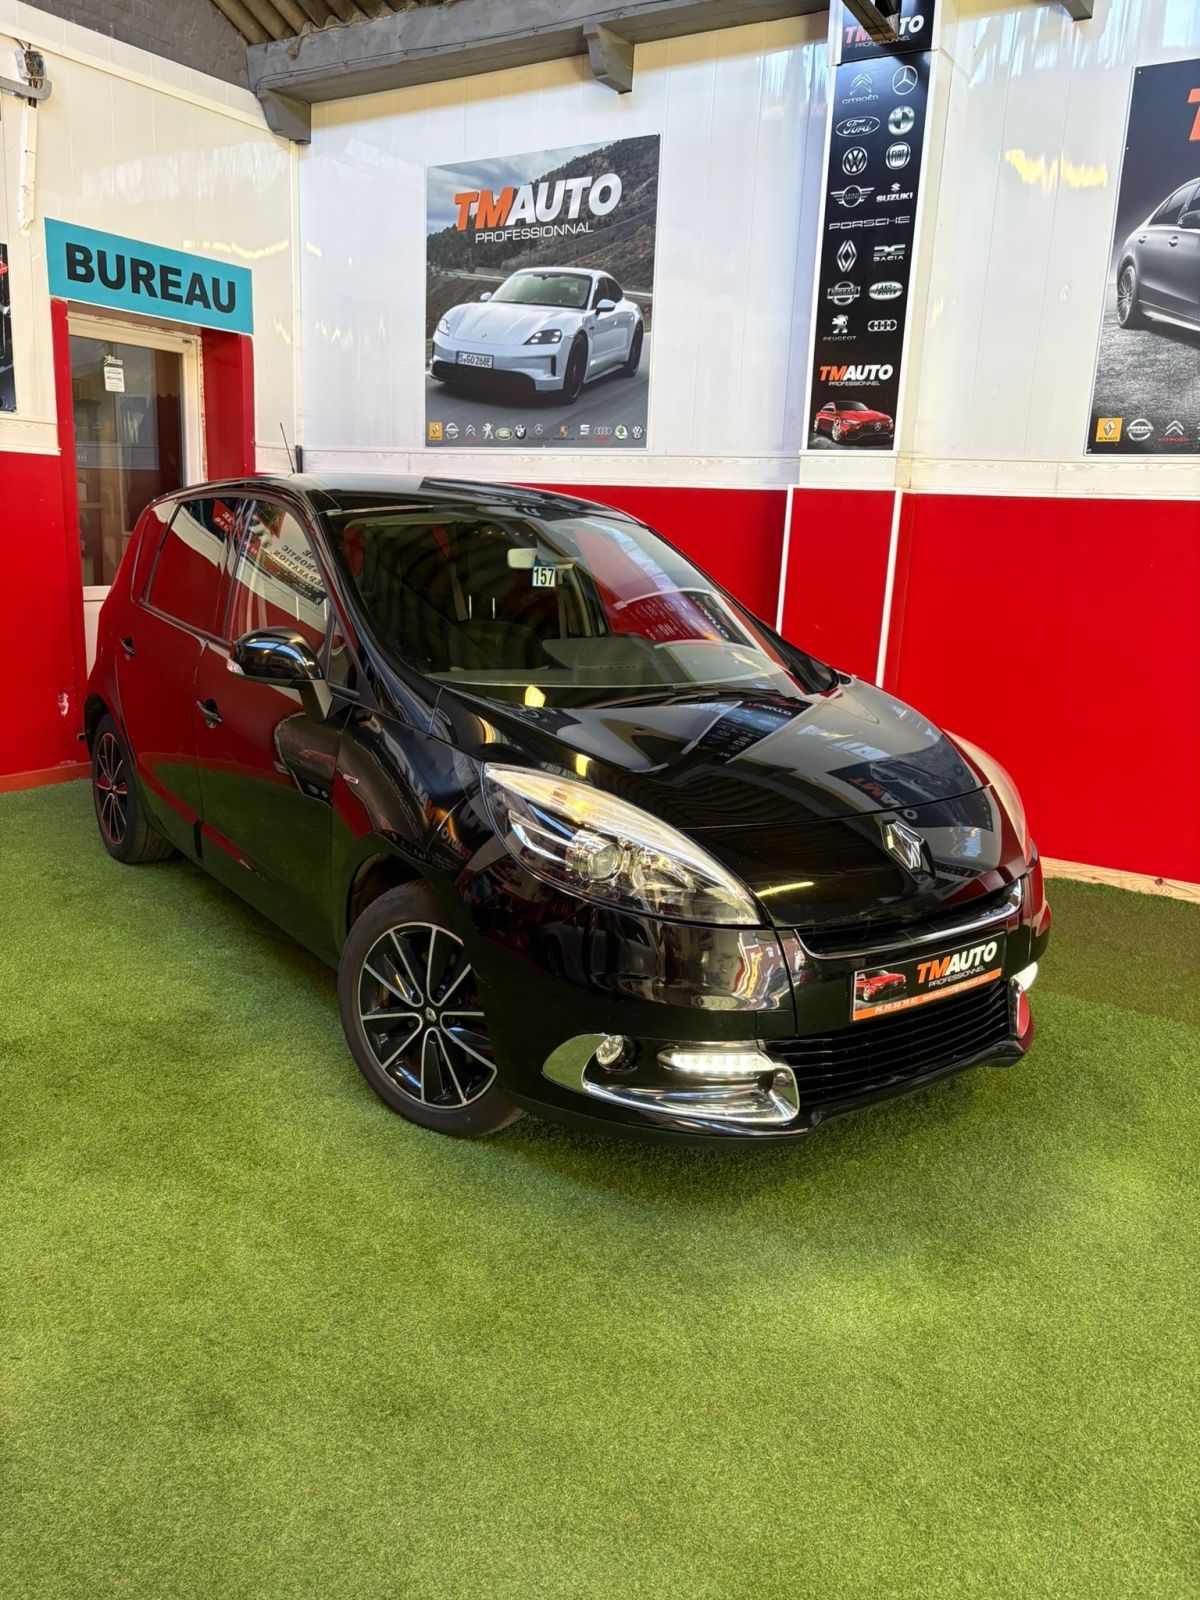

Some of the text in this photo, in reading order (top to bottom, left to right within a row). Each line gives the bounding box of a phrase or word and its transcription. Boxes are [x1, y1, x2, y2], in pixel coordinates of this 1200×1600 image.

[845, 15, 925, 44] TMTO
[842, 118, 873, 135] Ford
[890, 149, 906, 163] FIAT
[876, 192, 914, 203] SUZUKI
[829, 215, 911, 230] PORSCHE
[475, 222, 594, 244] PROFESSIONNAL
[65, 242, 236, 314] BUREAU
[820, 364, 894, 381] TMAUTO
[534, 567, 555, 586] 157
[917, 941, 998, 984] TMAUTO
[928, 965, 986, 988] PROFESSIONNEL
